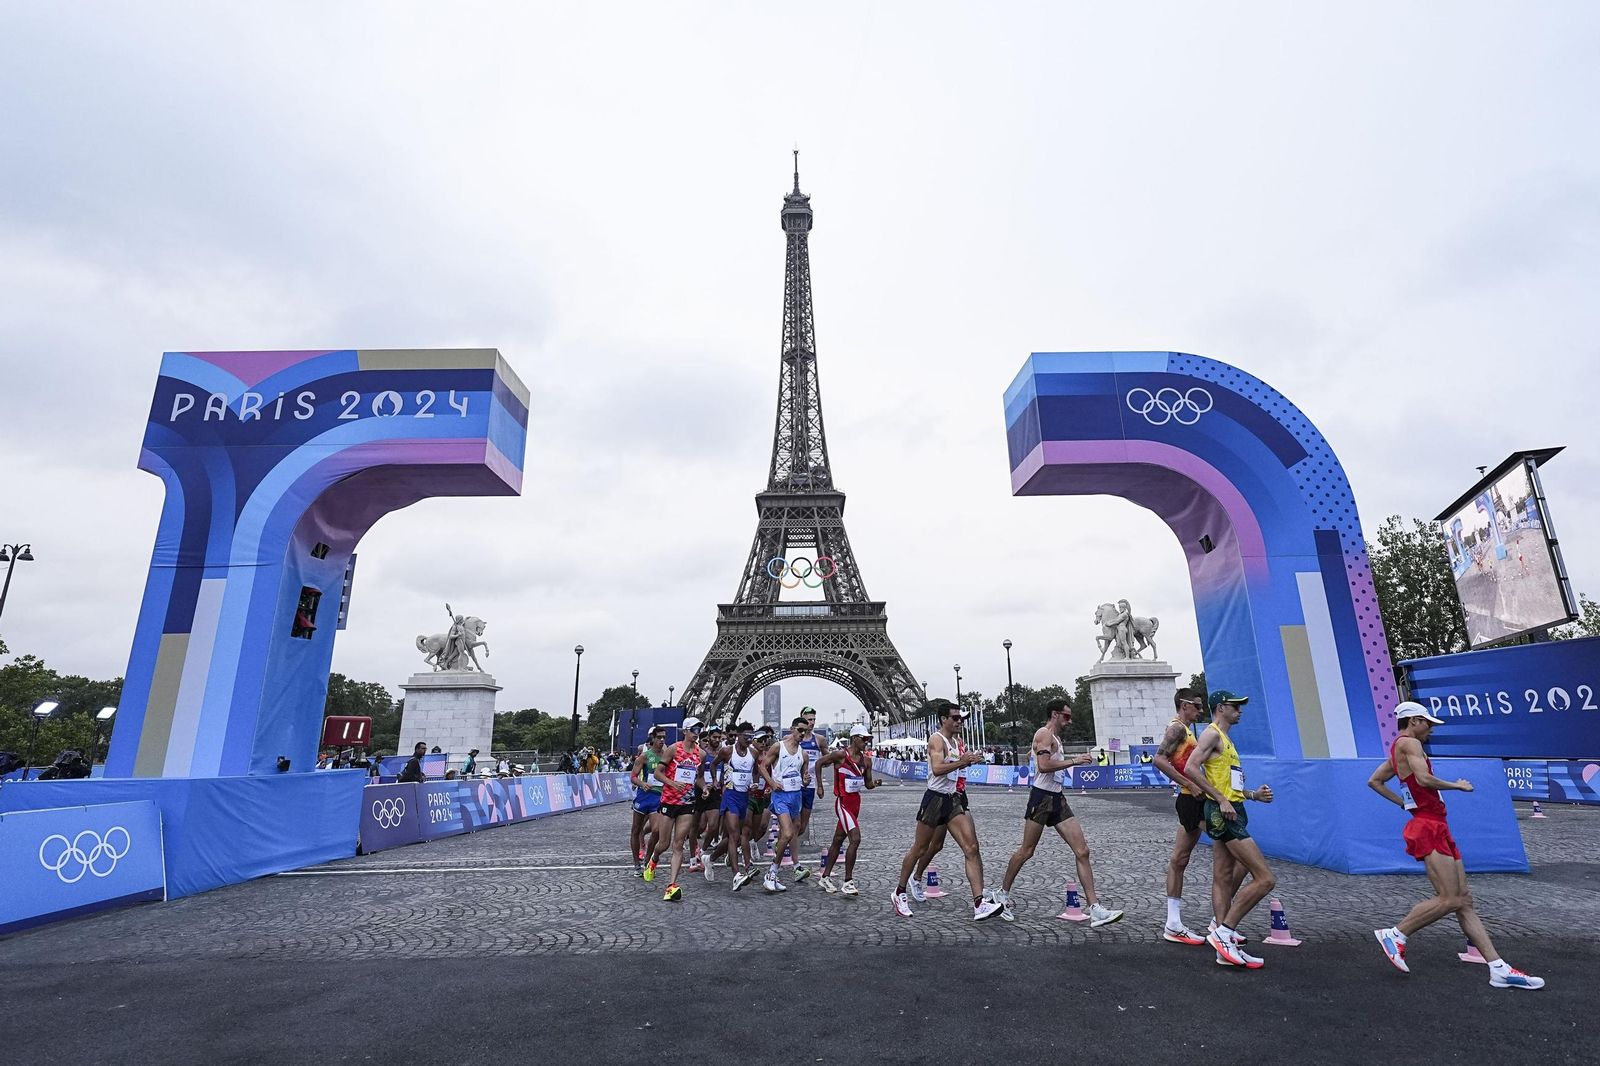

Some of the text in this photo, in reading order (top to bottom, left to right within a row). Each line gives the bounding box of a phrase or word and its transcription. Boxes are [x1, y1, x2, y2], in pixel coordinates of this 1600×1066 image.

[170, 389, 469, 422] PARiS 2024
[342, 721, 366, 740] 11
[427, 791, 452, 807] PARiS
[429, 808, 454, 824] 2024
